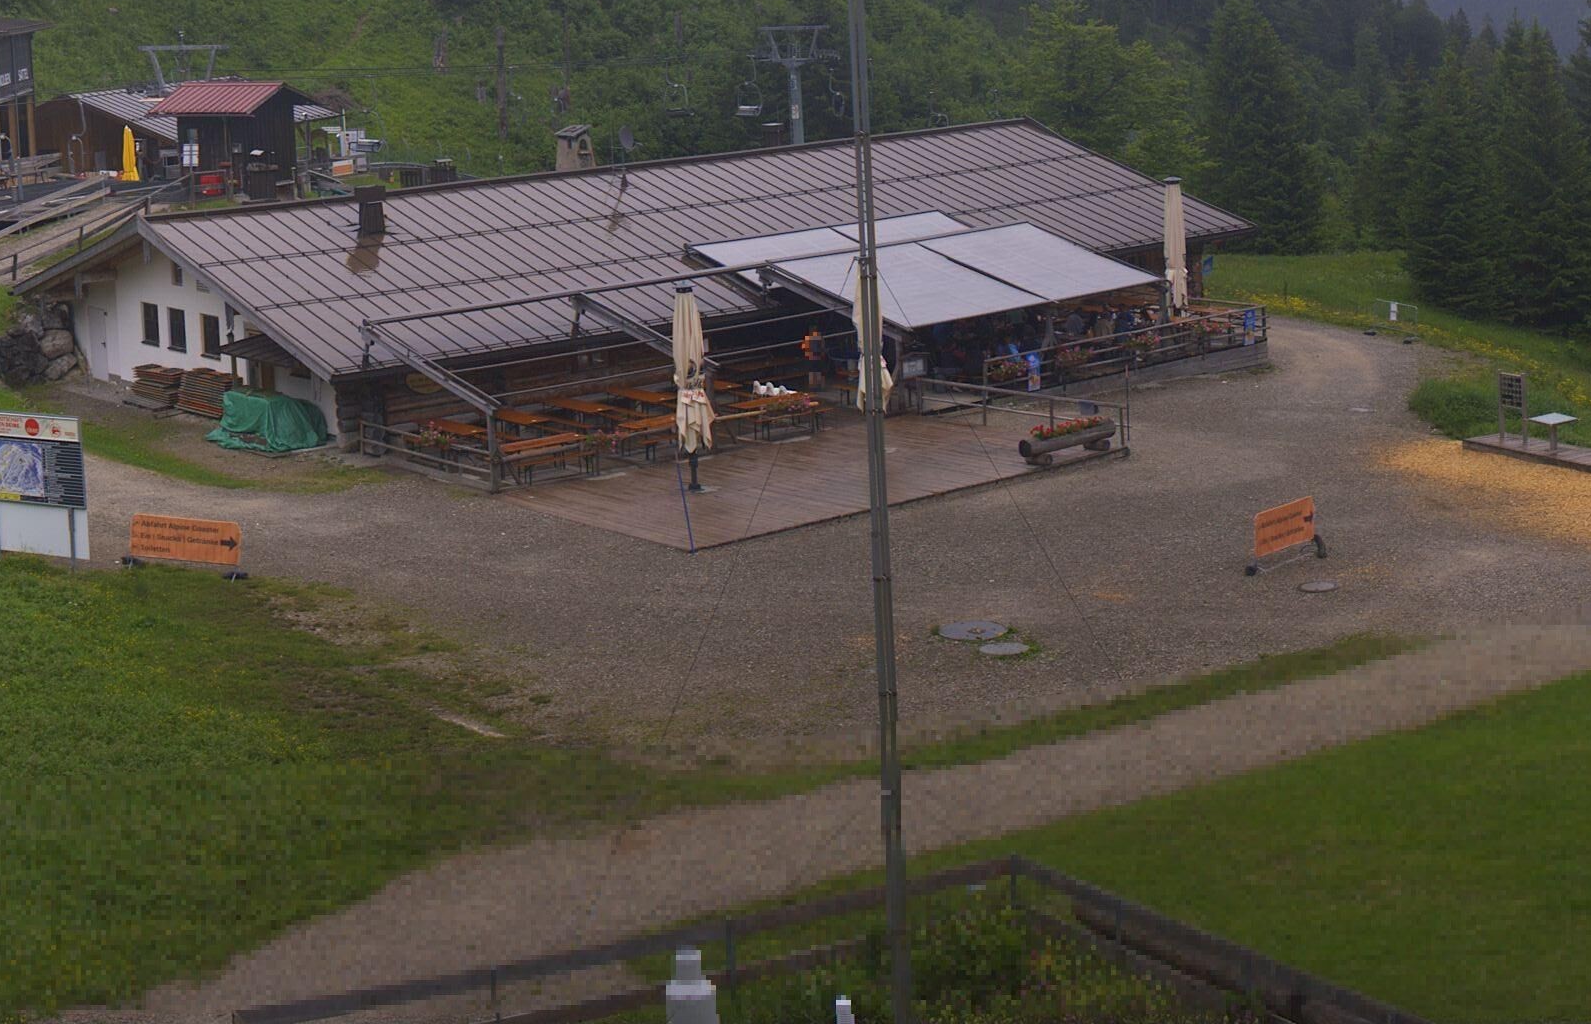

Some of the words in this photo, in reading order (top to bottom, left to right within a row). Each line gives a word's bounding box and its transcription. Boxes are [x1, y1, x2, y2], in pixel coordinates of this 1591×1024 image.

[141, 520, 167, 529] Abfahrt
[169, 523, 190, 531] Alpine
[140, 544, 170, 553] Toiletten
